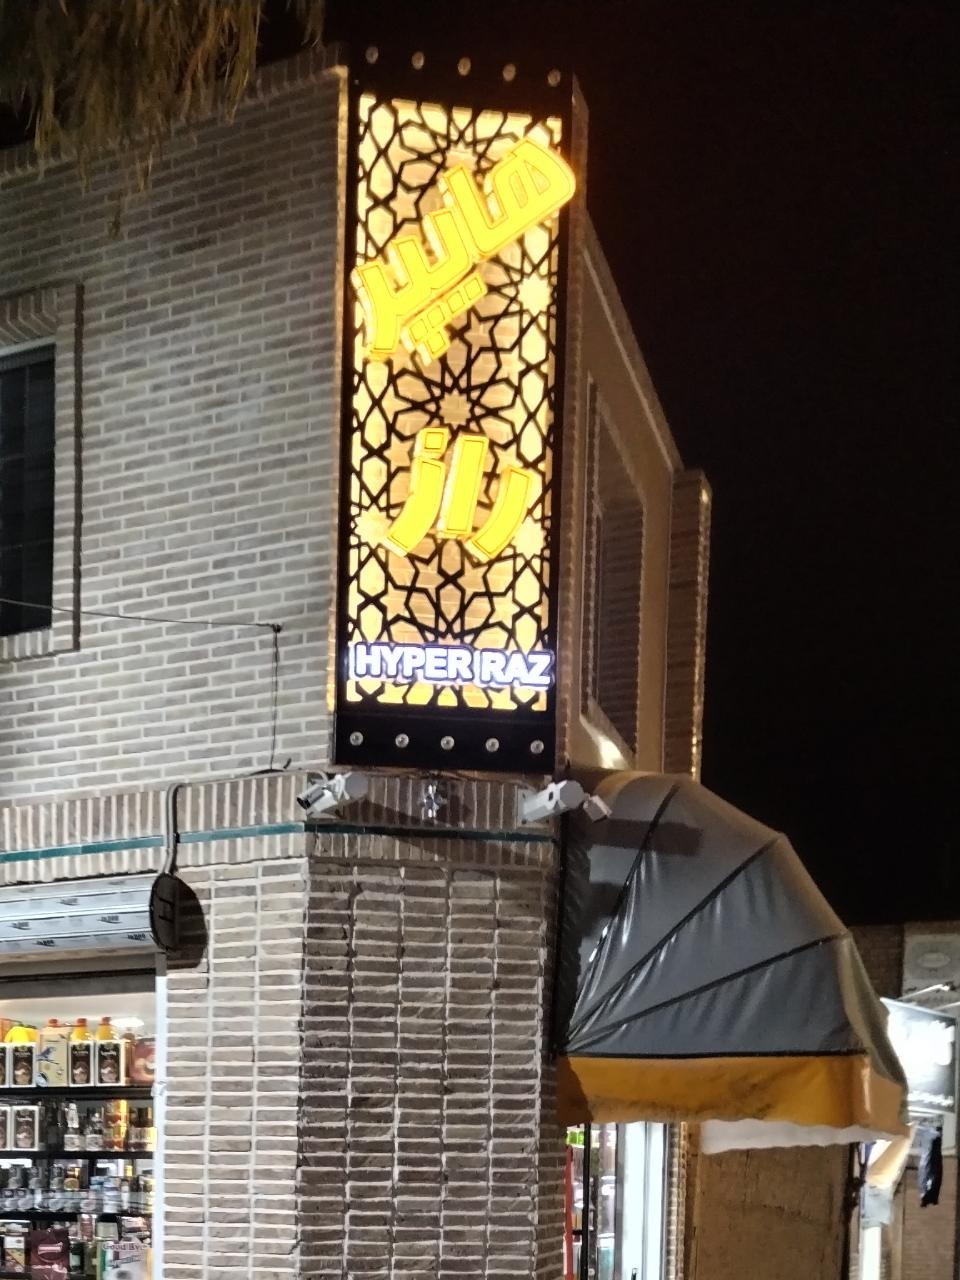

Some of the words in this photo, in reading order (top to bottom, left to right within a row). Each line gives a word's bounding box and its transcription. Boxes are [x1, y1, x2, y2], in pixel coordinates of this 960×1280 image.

[353, 138, 577, 361] هایپر
[387, 427, 533, 560] راز
[354, 642, 474, 681] HYPER
[480, 647, 552, 685] RAZ
